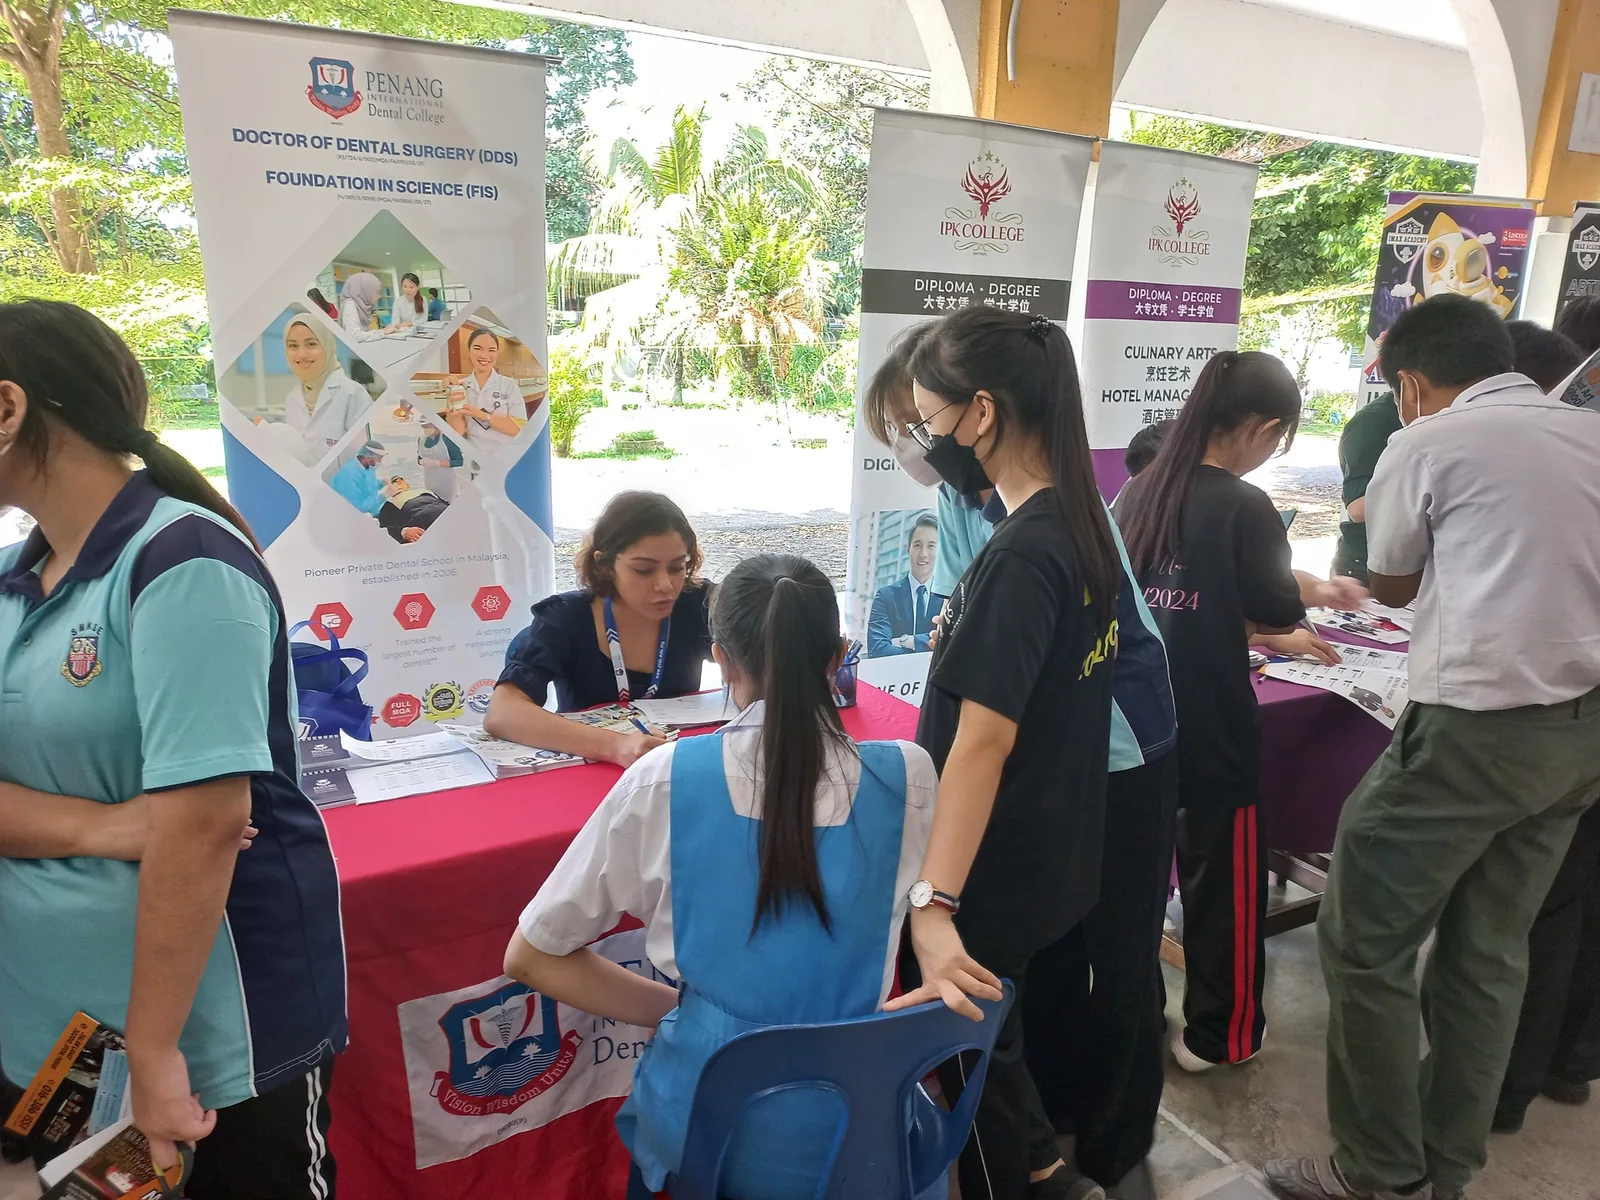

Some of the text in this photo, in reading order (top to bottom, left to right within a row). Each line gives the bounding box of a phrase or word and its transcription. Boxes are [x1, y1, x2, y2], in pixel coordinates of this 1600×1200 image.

[366, 71, 443, 99] PENANG
[367, 94, 444, 108] INTERNATIONAL
[368, 103, 444, 125] Dental College
[232, 128, 308, 148] DOCTOR
[310, 135, 333, 150] OF
[336, 137, 400, 155] DENTAL
[402, 143, 475, 161] SURGERY
[479, 149, 518, 166] (DDS)
[266, 170, 498, 200] FOUNDATION IN SCIENCE (FIS)
[940, 221, 1024, 241] IPK COLLEGE
[1148, 238, 1210, 255] IPK COLLEGE
[915, 278, 1040, 297] DIPLOMA DEGREE
[1129, 288, 1222, 303] DIPLOMA DEGREE
[923, 295, 969, 311] 大专文凭
[1135, 302, 1214, 318] 大专文凭 学士学位
[1124, 345, 1184, 360] CULINARY
[1145, 366, 1191, 382] 烹饪艺术
[1102, 389, 1141, 402] HOTEL
[863, 458, 901, 471] DIGI
[304, 552, 510, 578] Pioneer Private Dental School in Malaysia,
[361, 571, 419, 585] established
[422, 571, 431, 579] in
[483, 627, 511, 636] strong
[395, 635, 442, 647] Trained the
[465, 638, 512, 649] networking
[382, 649, 411, 660] largest
[413, 646, 445, 656] number
[900, 682, 920, 696] OF
[443, 1050, 574, 1115] Vision Wisdom Unity
